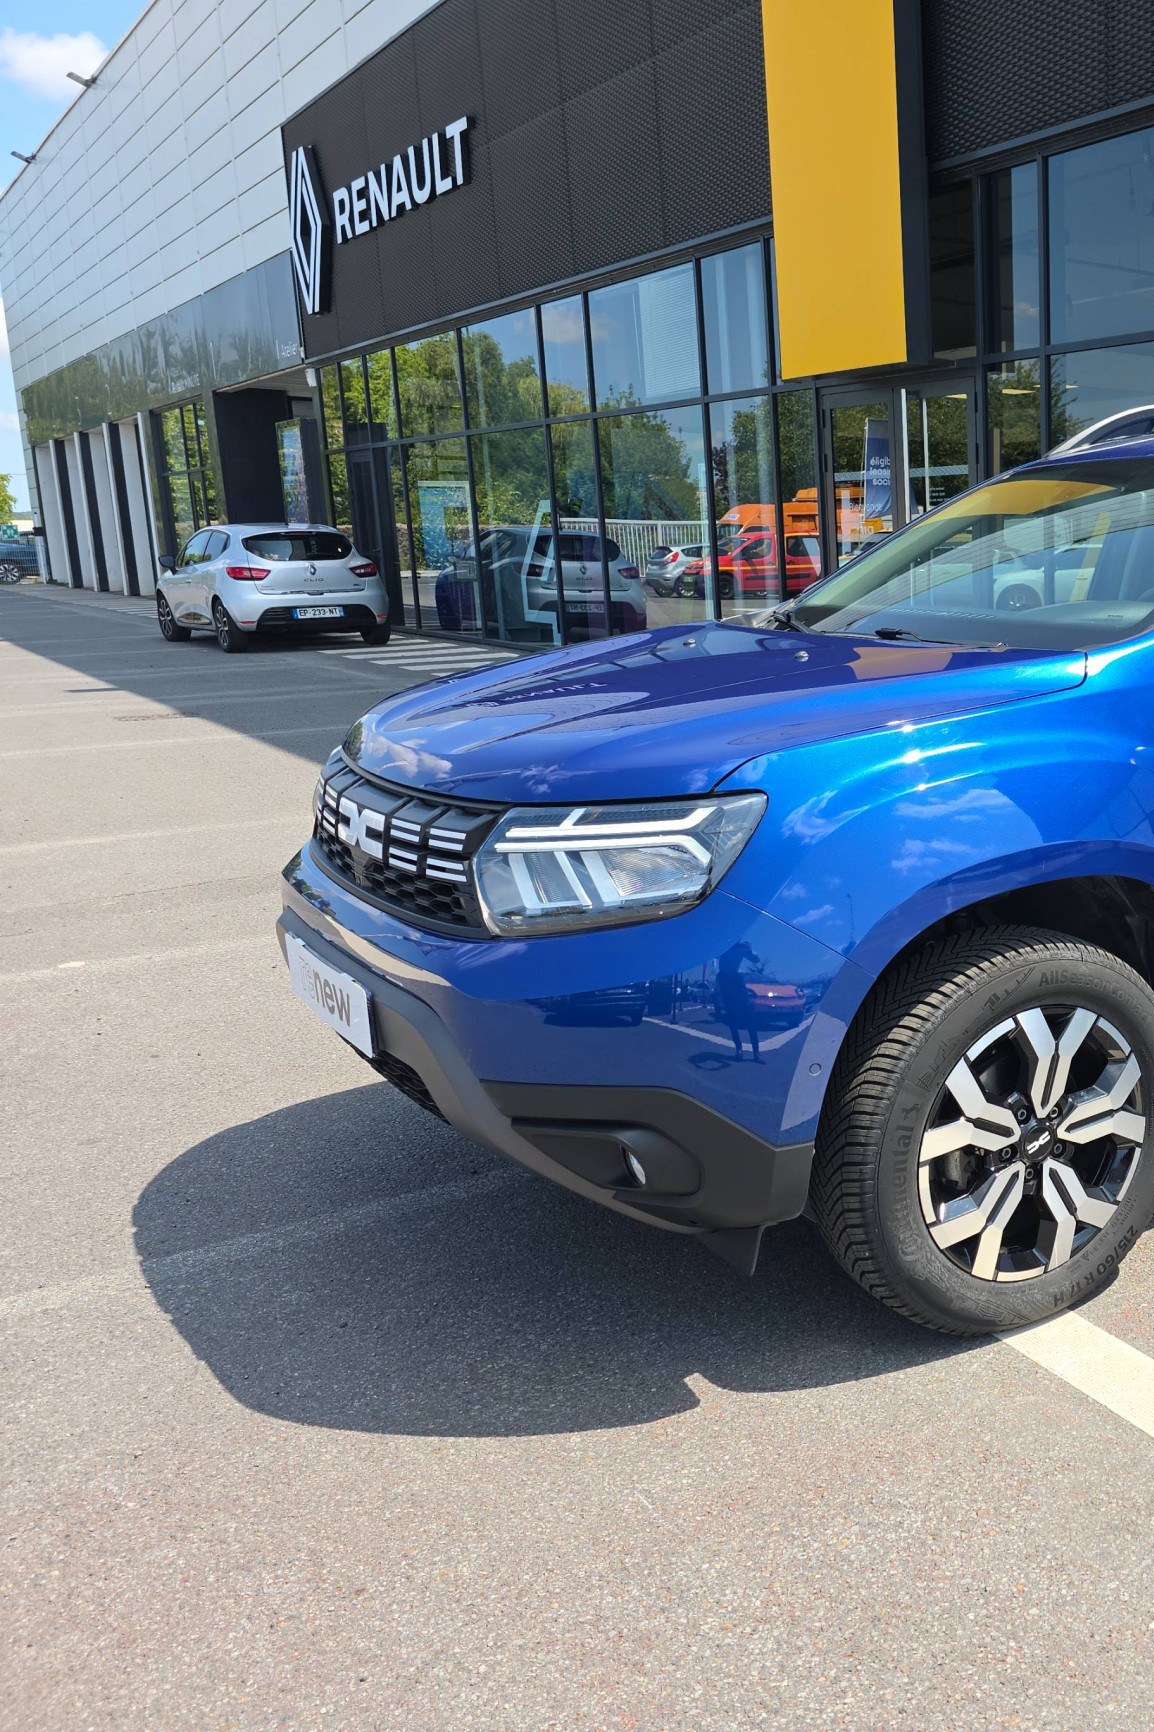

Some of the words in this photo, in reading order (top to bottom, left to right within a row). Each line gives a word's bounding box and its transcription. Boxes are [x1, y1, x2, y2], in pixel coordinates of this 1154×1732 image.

[332, 116, 468, 244] RENAULT
[870, 456, 890, 467] éligib
[870, 467, 890, 475] leasi
